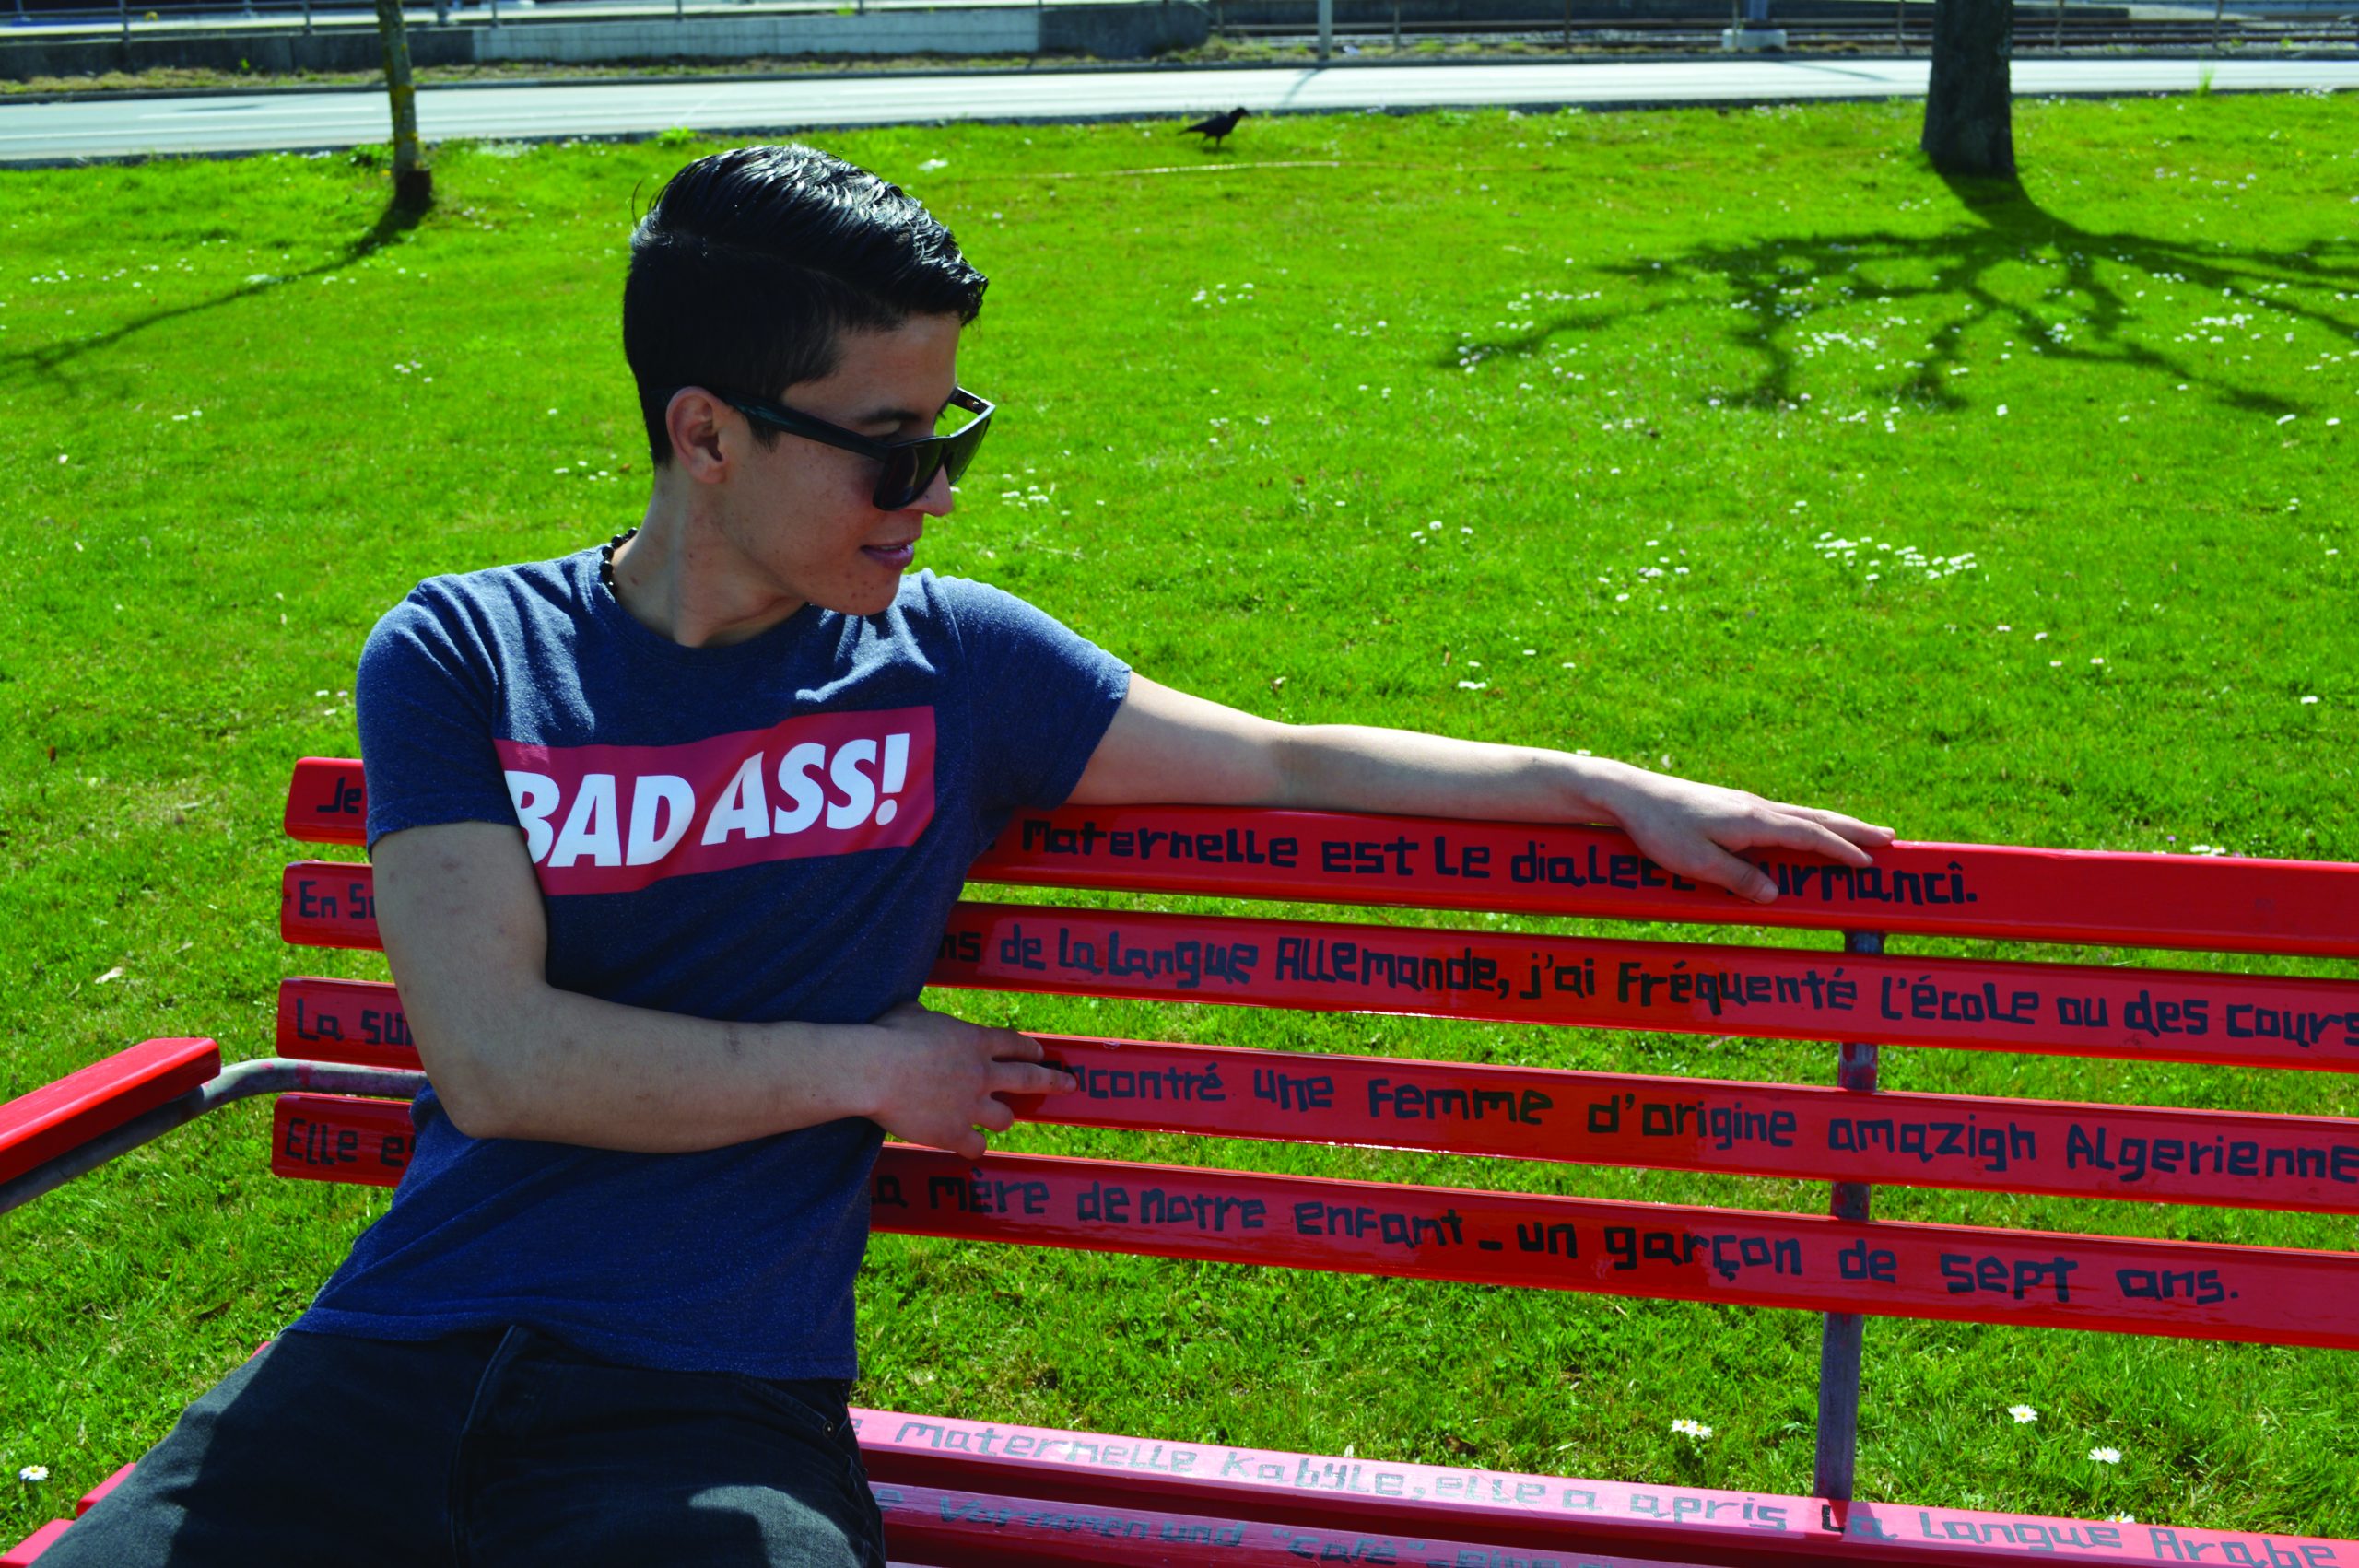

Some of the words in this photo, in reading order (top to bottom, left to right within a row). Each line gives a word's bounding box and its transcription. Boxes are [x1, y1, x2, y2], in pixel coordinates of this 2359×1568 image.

[316, 777, 362, 814] Je
[504, 770, 695, 867] BAD
[701, 733, 910, 846] ASS!
[1022, 819, 1298, 868] Maternelle
[1321, 836, 1419, 877] est
[298, 881, 337, 919] En
[348, 883, 375, 919] S
[1000, 923, 1046, 971] de
[1275, 936, 1509, 1000] Allemande,
[1519, 953, 1596, 1000] j'ai
[1617, 960, 1858, 1017] Fréquenté
[2056, 997, 2110, 1028] ou
[2123, 989, 2209, 1037] des
[361, 1010, 415, 1046] su
[284, 1117, 358, 1166] Elle
[381, 1134, 415, 1169] e
[1587, 1093, 1797, 1151] d'origine
[1828, 1114, 2036, 1172] amazigh
[2067, 1123, 2359, 1183] Algerienne
[928, 1168, 1050, 1215] mère
[1077, 1180, 1131, 1223] de
[1140, 1188, 1267, 1233] notre
[1294, 1201, 1463, 1249] enfant
[1517, 1221, 1579, 1259] un
[1604, 1226, 1803, 1282] garçon
[1838, 1239, 1897, 1284] de
[1940, 1253, 2079, 1303] sept
[2116, 1269, 2239, 1305] ans.
[1562, 1489, 1605, 1513] a
[1630, 1493, 1787, 1532] apris
[2148, 1527, 2341, 1568] Arabe
